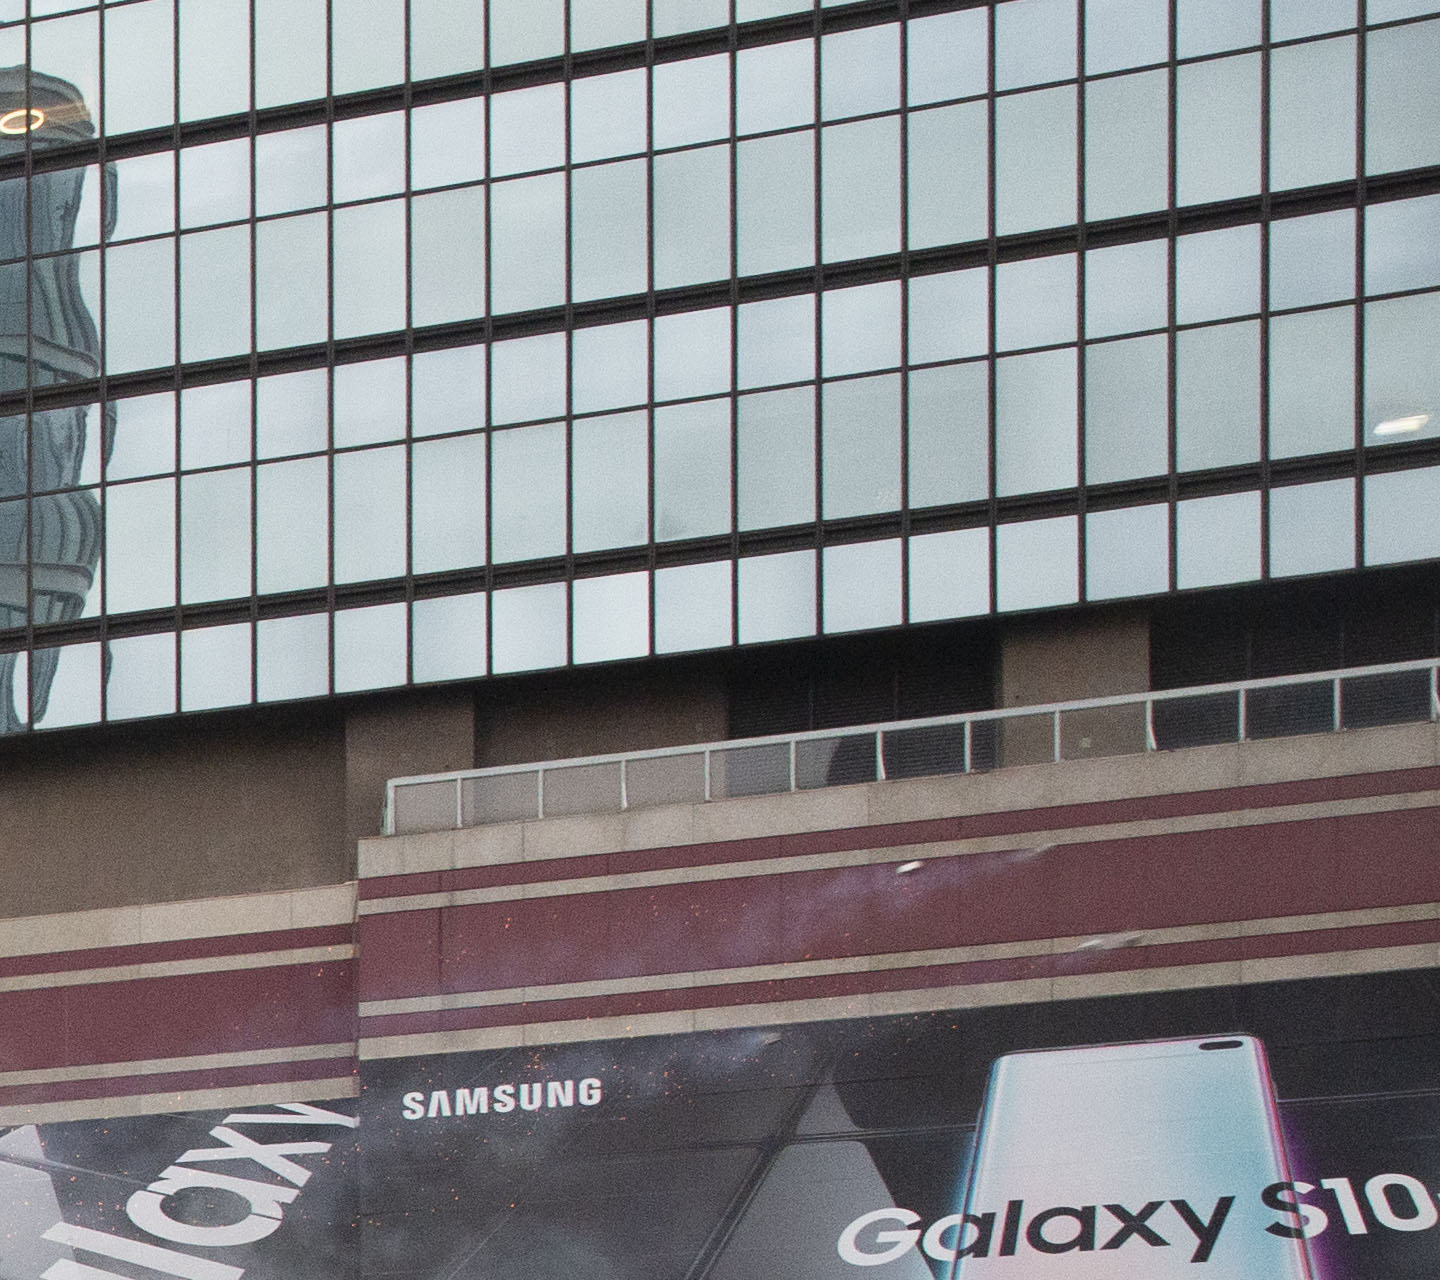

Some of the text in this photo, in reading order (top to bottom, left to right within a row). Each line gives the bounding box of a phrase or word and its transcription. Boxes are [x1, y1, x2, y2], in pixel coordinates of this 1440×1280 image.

[402, 1077, 602, 1121] SAMSUNG
[837, 1172, 1440, 1266] Galaxy S10
